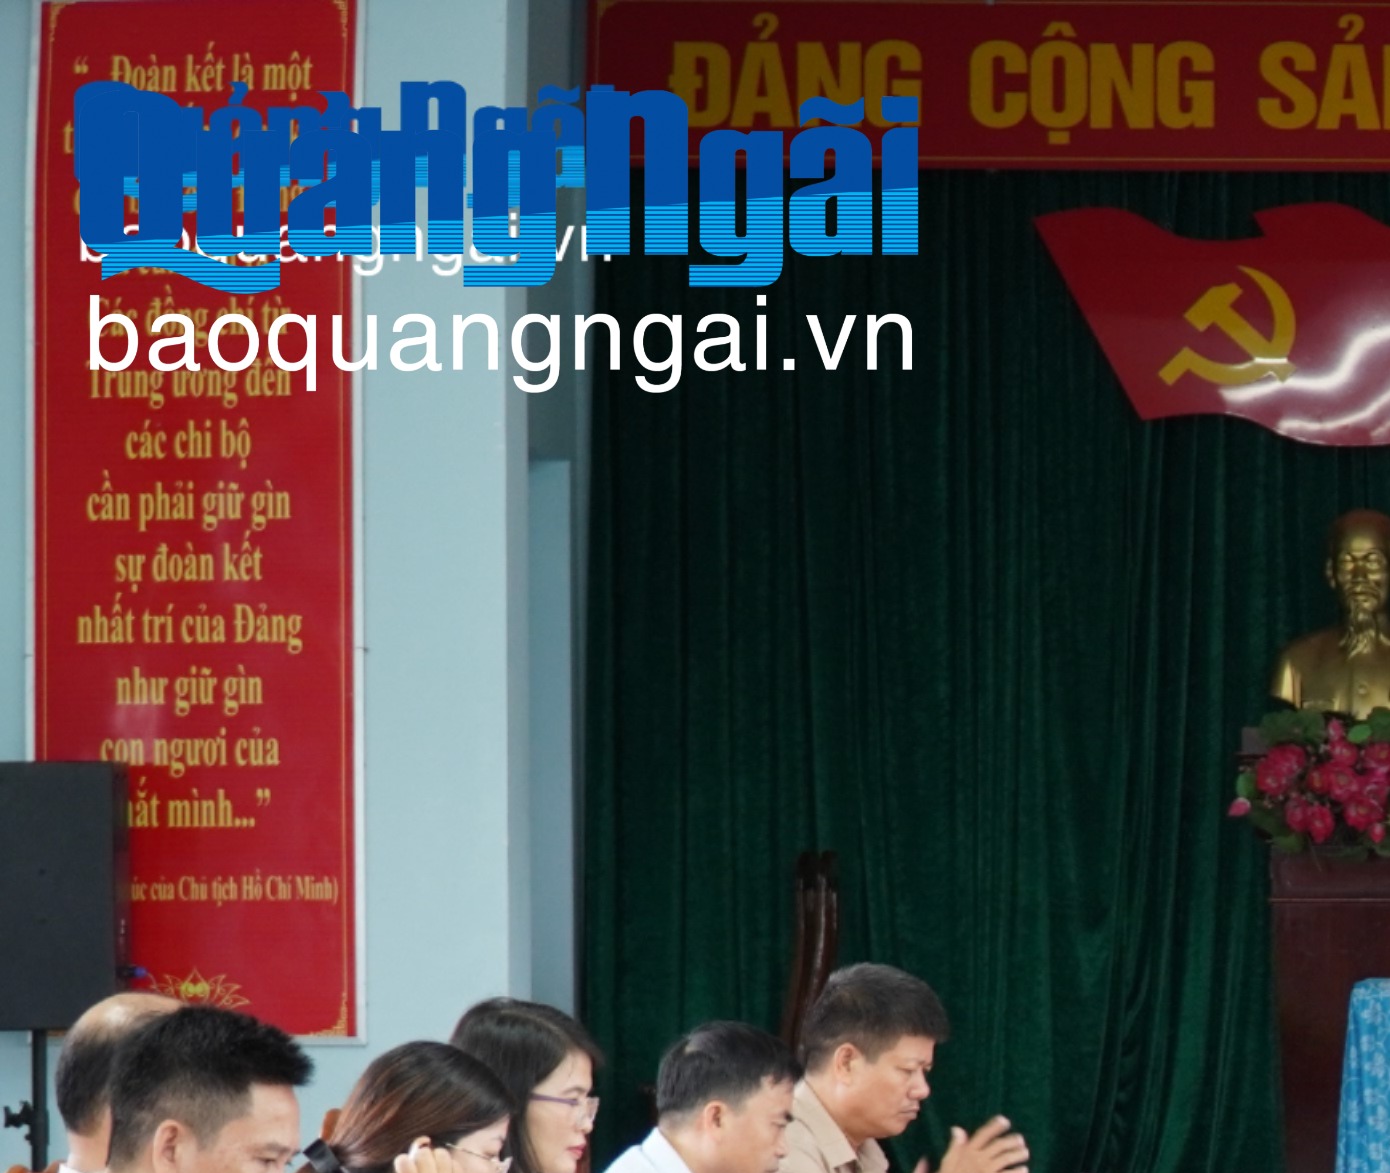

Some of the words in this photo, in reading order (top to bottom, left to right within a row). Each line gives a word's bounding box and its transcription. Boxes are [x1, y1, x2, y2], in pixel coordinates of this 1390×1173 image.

[110, 48, 177, 91] Đoàn
[185, 41, 225, 91] kết
[233, 47, 253, 90] là
[263, 50, 312, 101] một
[667, 12, 922, 128] ĐẢNG
[970, 24, 1215, 145] CỘNG
[125, 420, 166, 460] các
[174, 420, 212, 458] chi
[220, 418, 251, 469] bộ
[87, 469, 130, 520] cần
[139, 481, 194, 531] phải
[203, 481, 244, 531] giữ
[251, 480, 291, 531] gìn
[115, 553, 145, 592] sự
[152, 542, 214, 581] đoàn
[223, 530, 262, 581] kết
[77, 592, 134, 643] nhất
[142, 604, 174, 643] trí
[181, 604, 225, 643] của
[234, 604, 302, 654] Đảng
[116, 666, 168, 705] như
[175, 665, 216, 715] giữ
[223, 664, 262, 715] gìn
[101, 737, 145, 766] con
[153, 727, 227, 778] ngươi
[235, 727, 279, 766] của
[151, 876, 174, 901] của
[178, 874, 208, 901] Chủ
[211, 875, 237, 906] tịch
[242, 868, 262, 901] Hồ
[265, 874, 291, 901] Chí
[296, 874, 338, 906] Minh)
